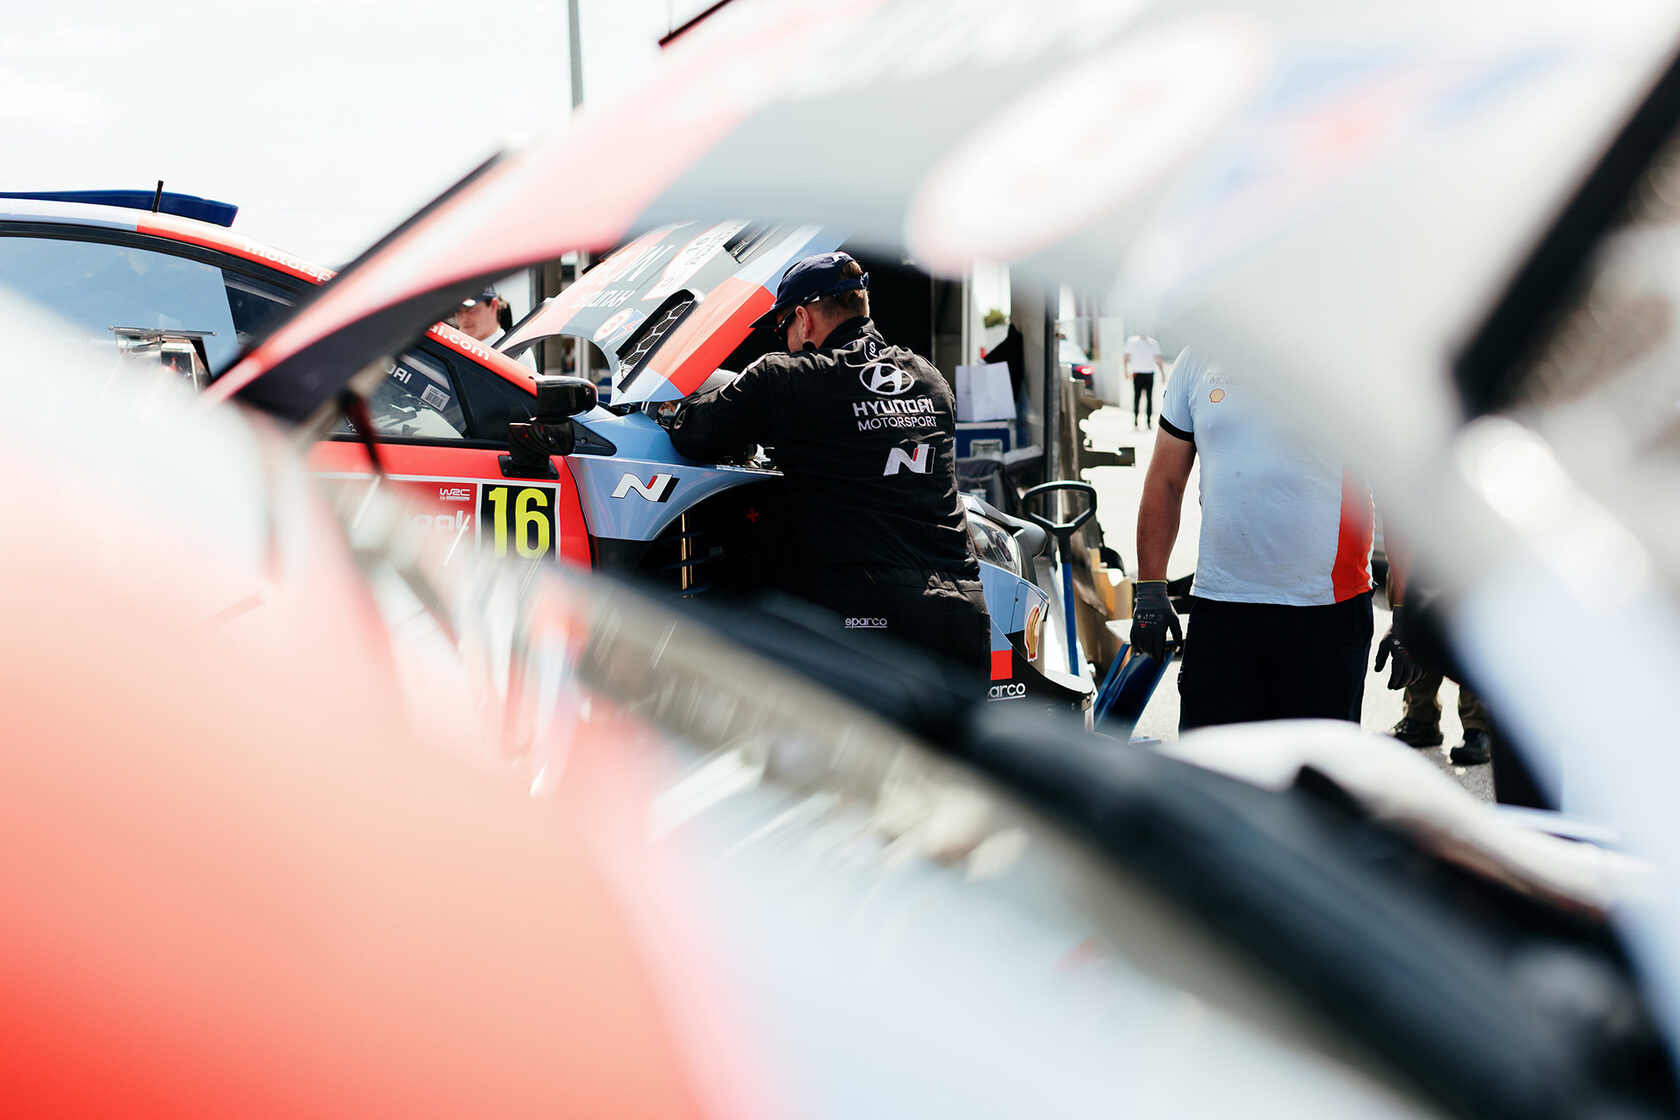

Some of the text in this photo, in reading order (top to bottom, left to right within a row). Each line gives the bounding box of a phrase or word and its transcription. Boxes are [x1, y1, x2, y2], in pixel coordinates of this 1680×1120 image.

[853, 398, 935, 417] HYUNDAI
[857, 416, 938, 431] MOTORSPORT
[439, 487, 471, 497] WRC
[488, 486, 550, 560] 16
[844, 617, 888, 629] sparco
